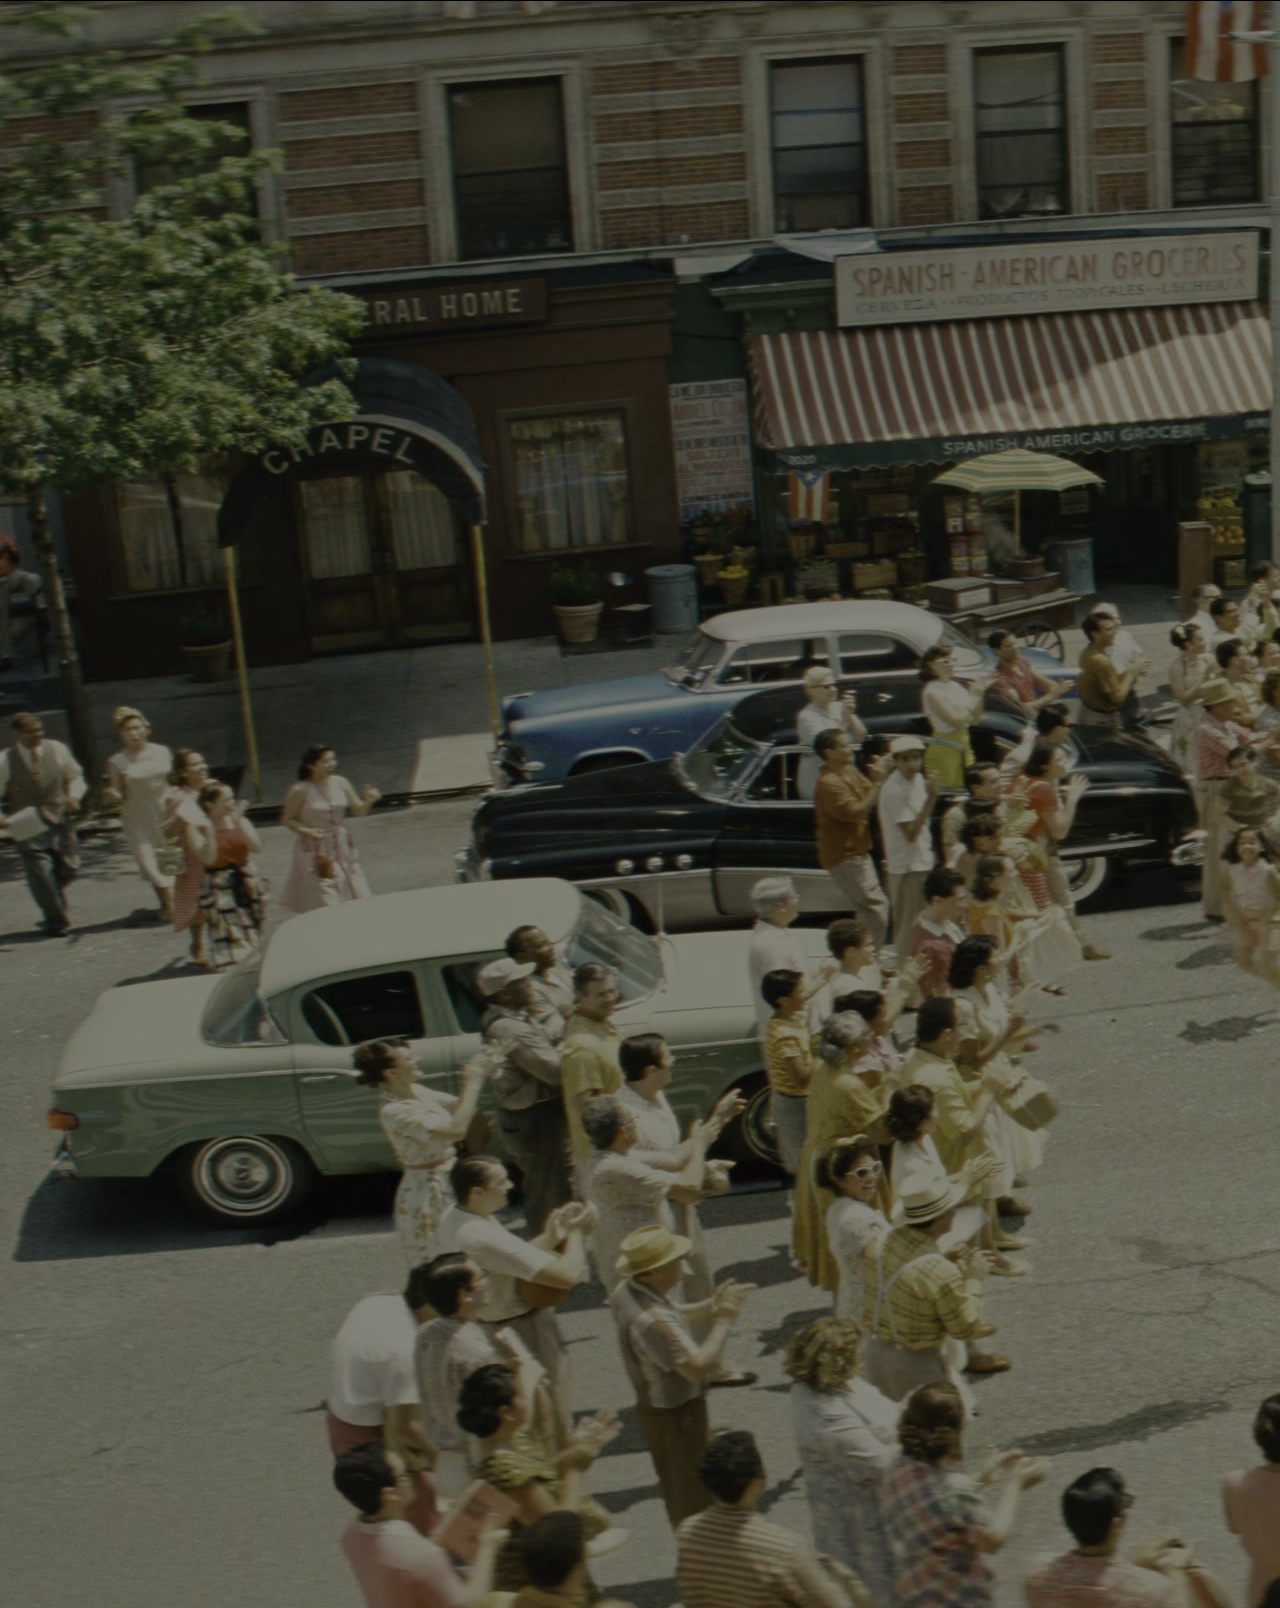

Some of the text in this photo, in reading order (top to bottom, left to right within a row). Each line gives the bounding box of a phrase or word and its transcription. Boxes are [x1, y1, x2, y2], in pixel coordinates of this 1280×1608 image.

[852, 262, 955, 297] SPANISH
[973, 253, 1098, 289] AMERICAN
[1111, 244, 1249, 280] GROCERIES
[440, 288, 524, 319] HOME
[855, 298, 938, 315] CERVEZA
[261, 425, 415, 475] CHAPEL
[943, 437, 1017, 456] SPANISH
[1023, 429, 1115, 450] AMERICAN
